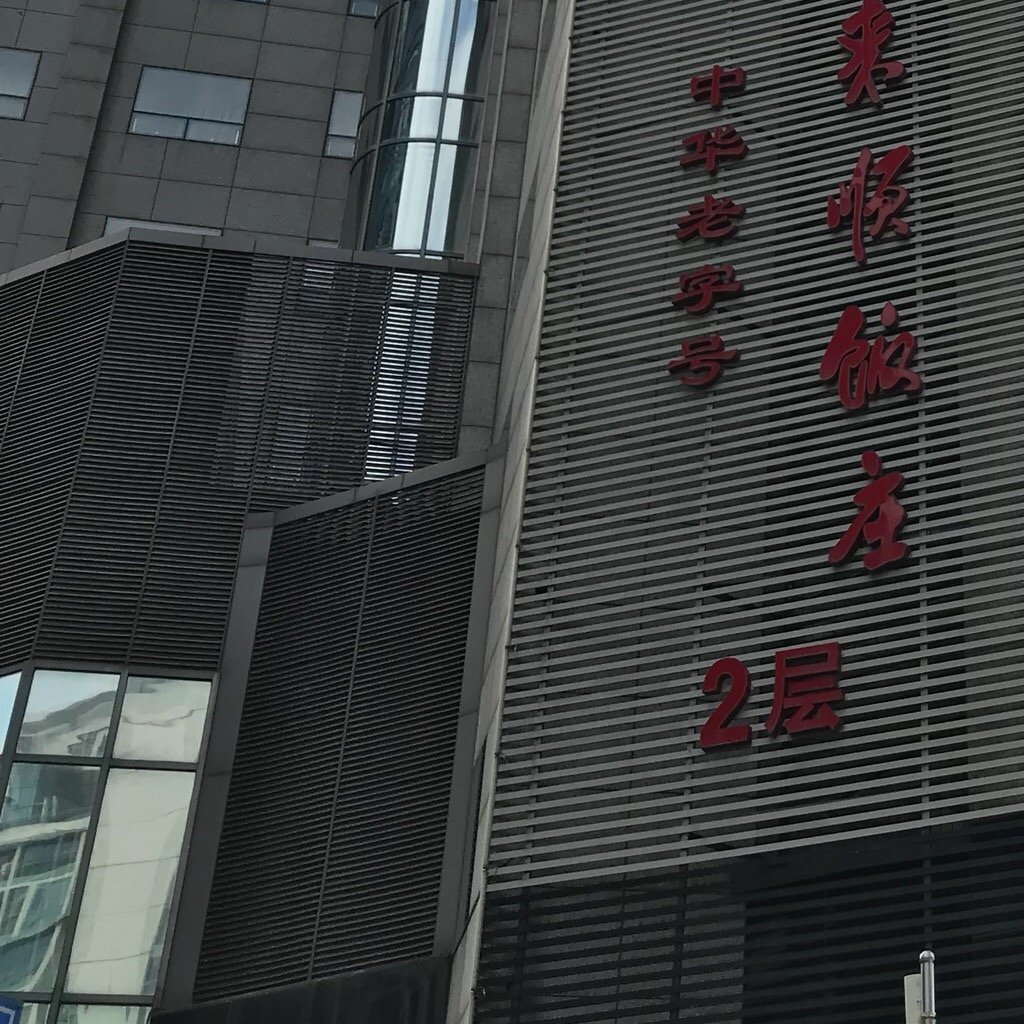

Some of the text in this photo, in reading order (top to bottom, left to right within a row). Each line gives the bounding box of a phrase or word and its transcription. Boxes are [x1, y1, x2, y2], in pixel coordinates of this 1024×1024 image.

[667, 63, 750, 389] 中华老字号
[700, 641, 846, 754] 2层
